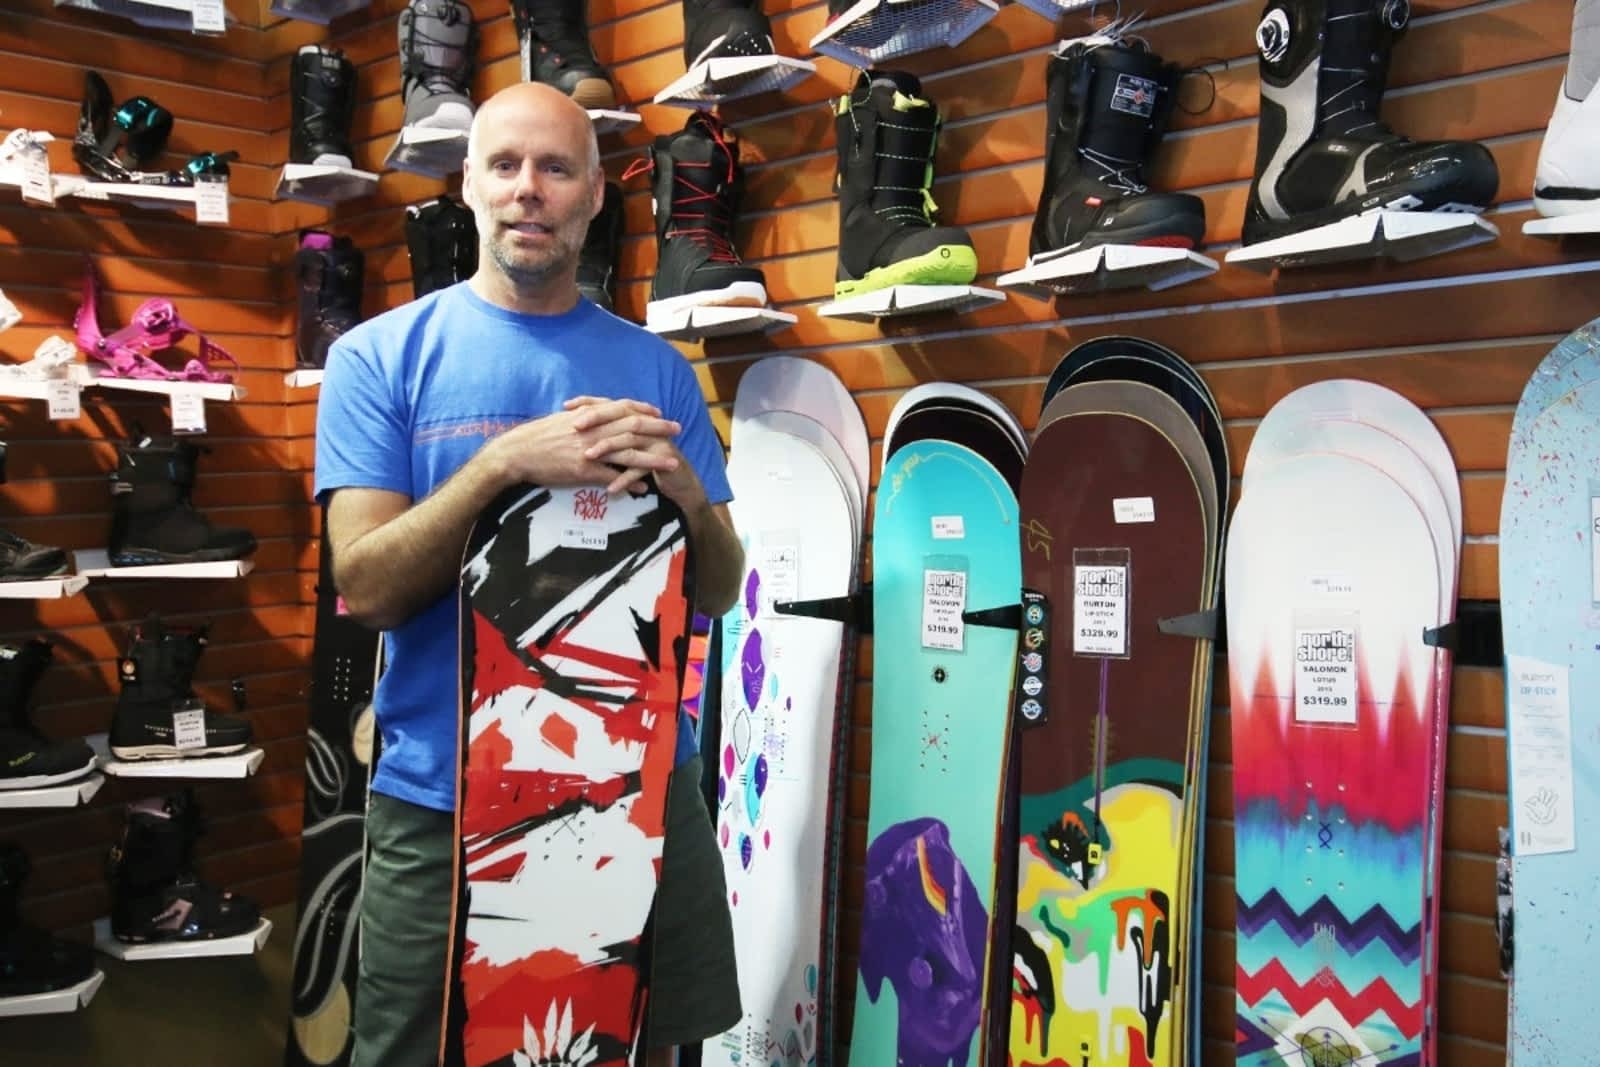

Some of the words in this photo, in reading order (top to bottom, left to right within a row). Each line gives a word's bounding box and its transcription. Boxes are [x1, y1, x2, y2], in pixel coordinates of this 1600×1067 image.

[1080, 628, 1119, 639] $329.99
[1301, 630, 1348, 648] north
[1297, 646, 1349, 662] shore
[1303, 665, 1347, 673] SALOMON
[1312, 676, 1337, 684] LOTUS
[1303, 695, 1348, 706] $319.99
